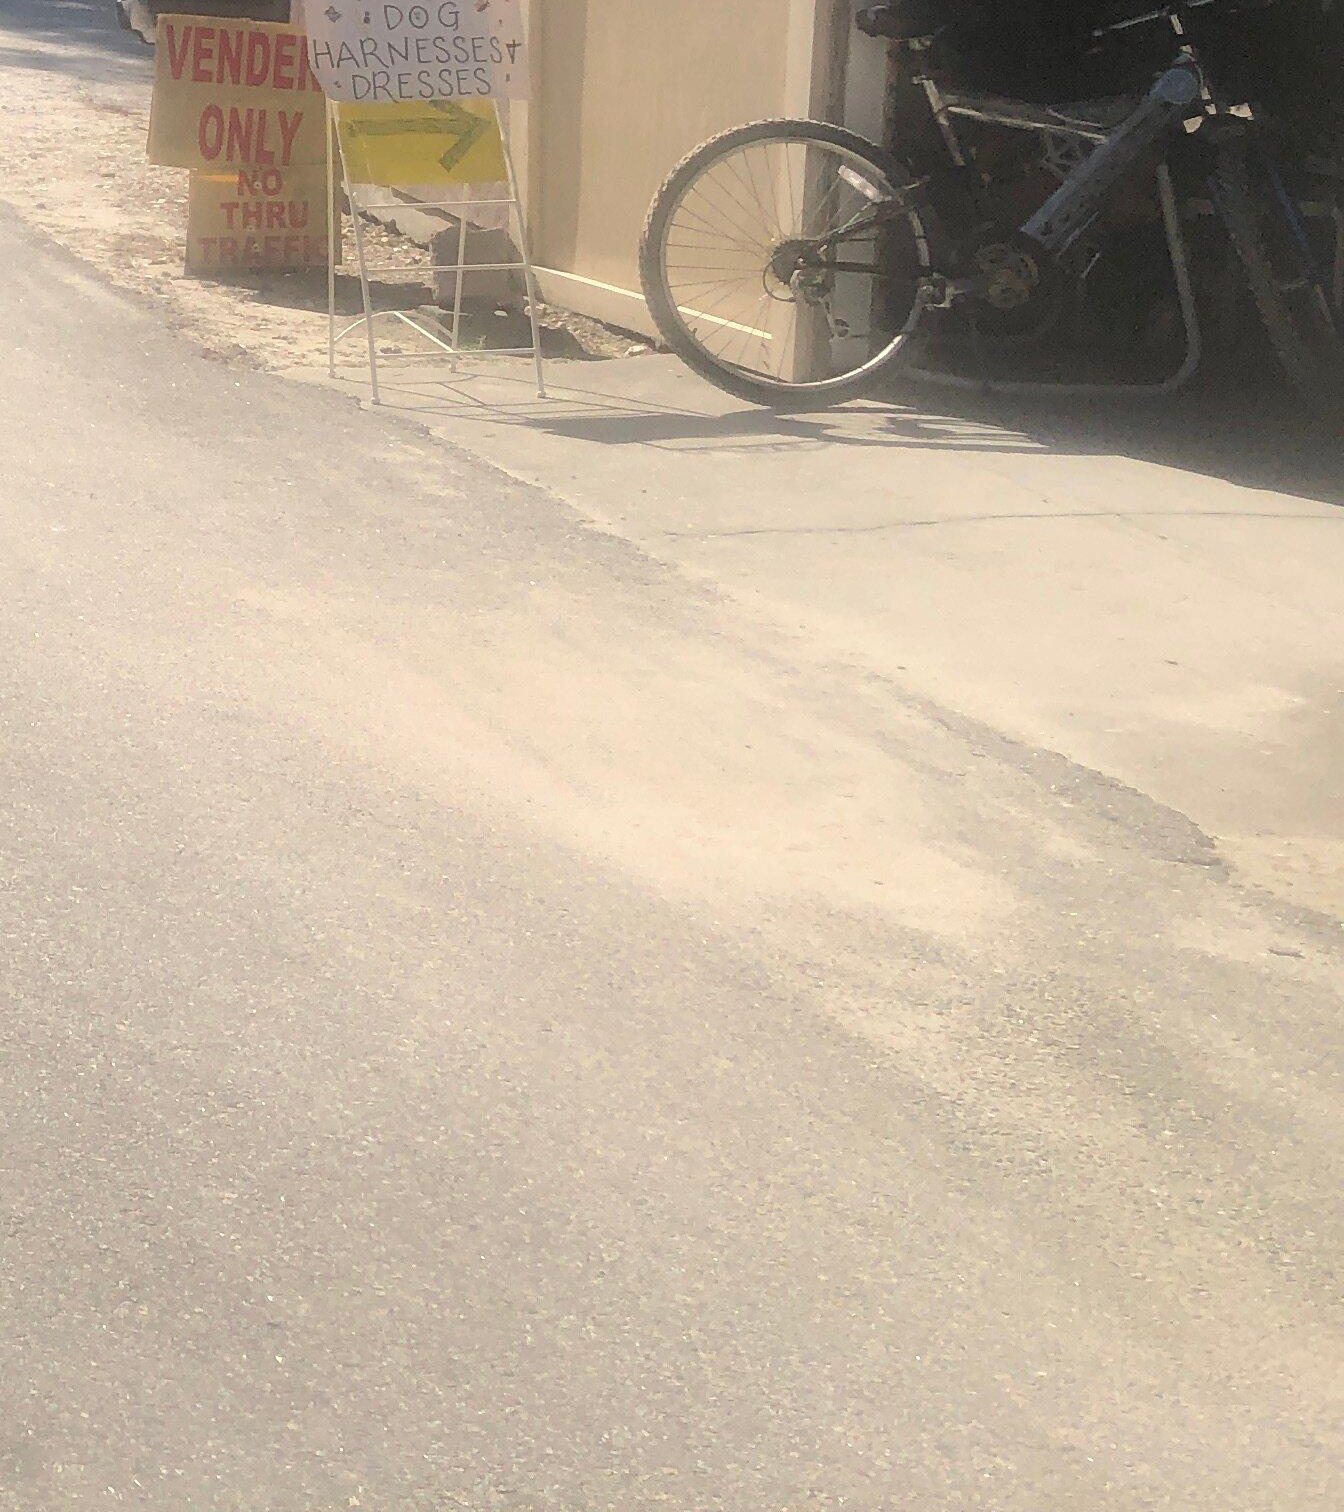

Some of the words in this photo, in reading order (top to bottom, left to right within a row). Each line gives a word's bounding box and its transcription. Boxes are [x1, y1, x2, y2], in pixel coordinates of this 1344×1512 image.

[383, 1, 461, 31] DOG
[351, 67, 492, 104] DRESSES
[198, 102, 304, 167] ONLY
[237, 168, 285, 197] NO
[219, 201, 309, 229] THRU
